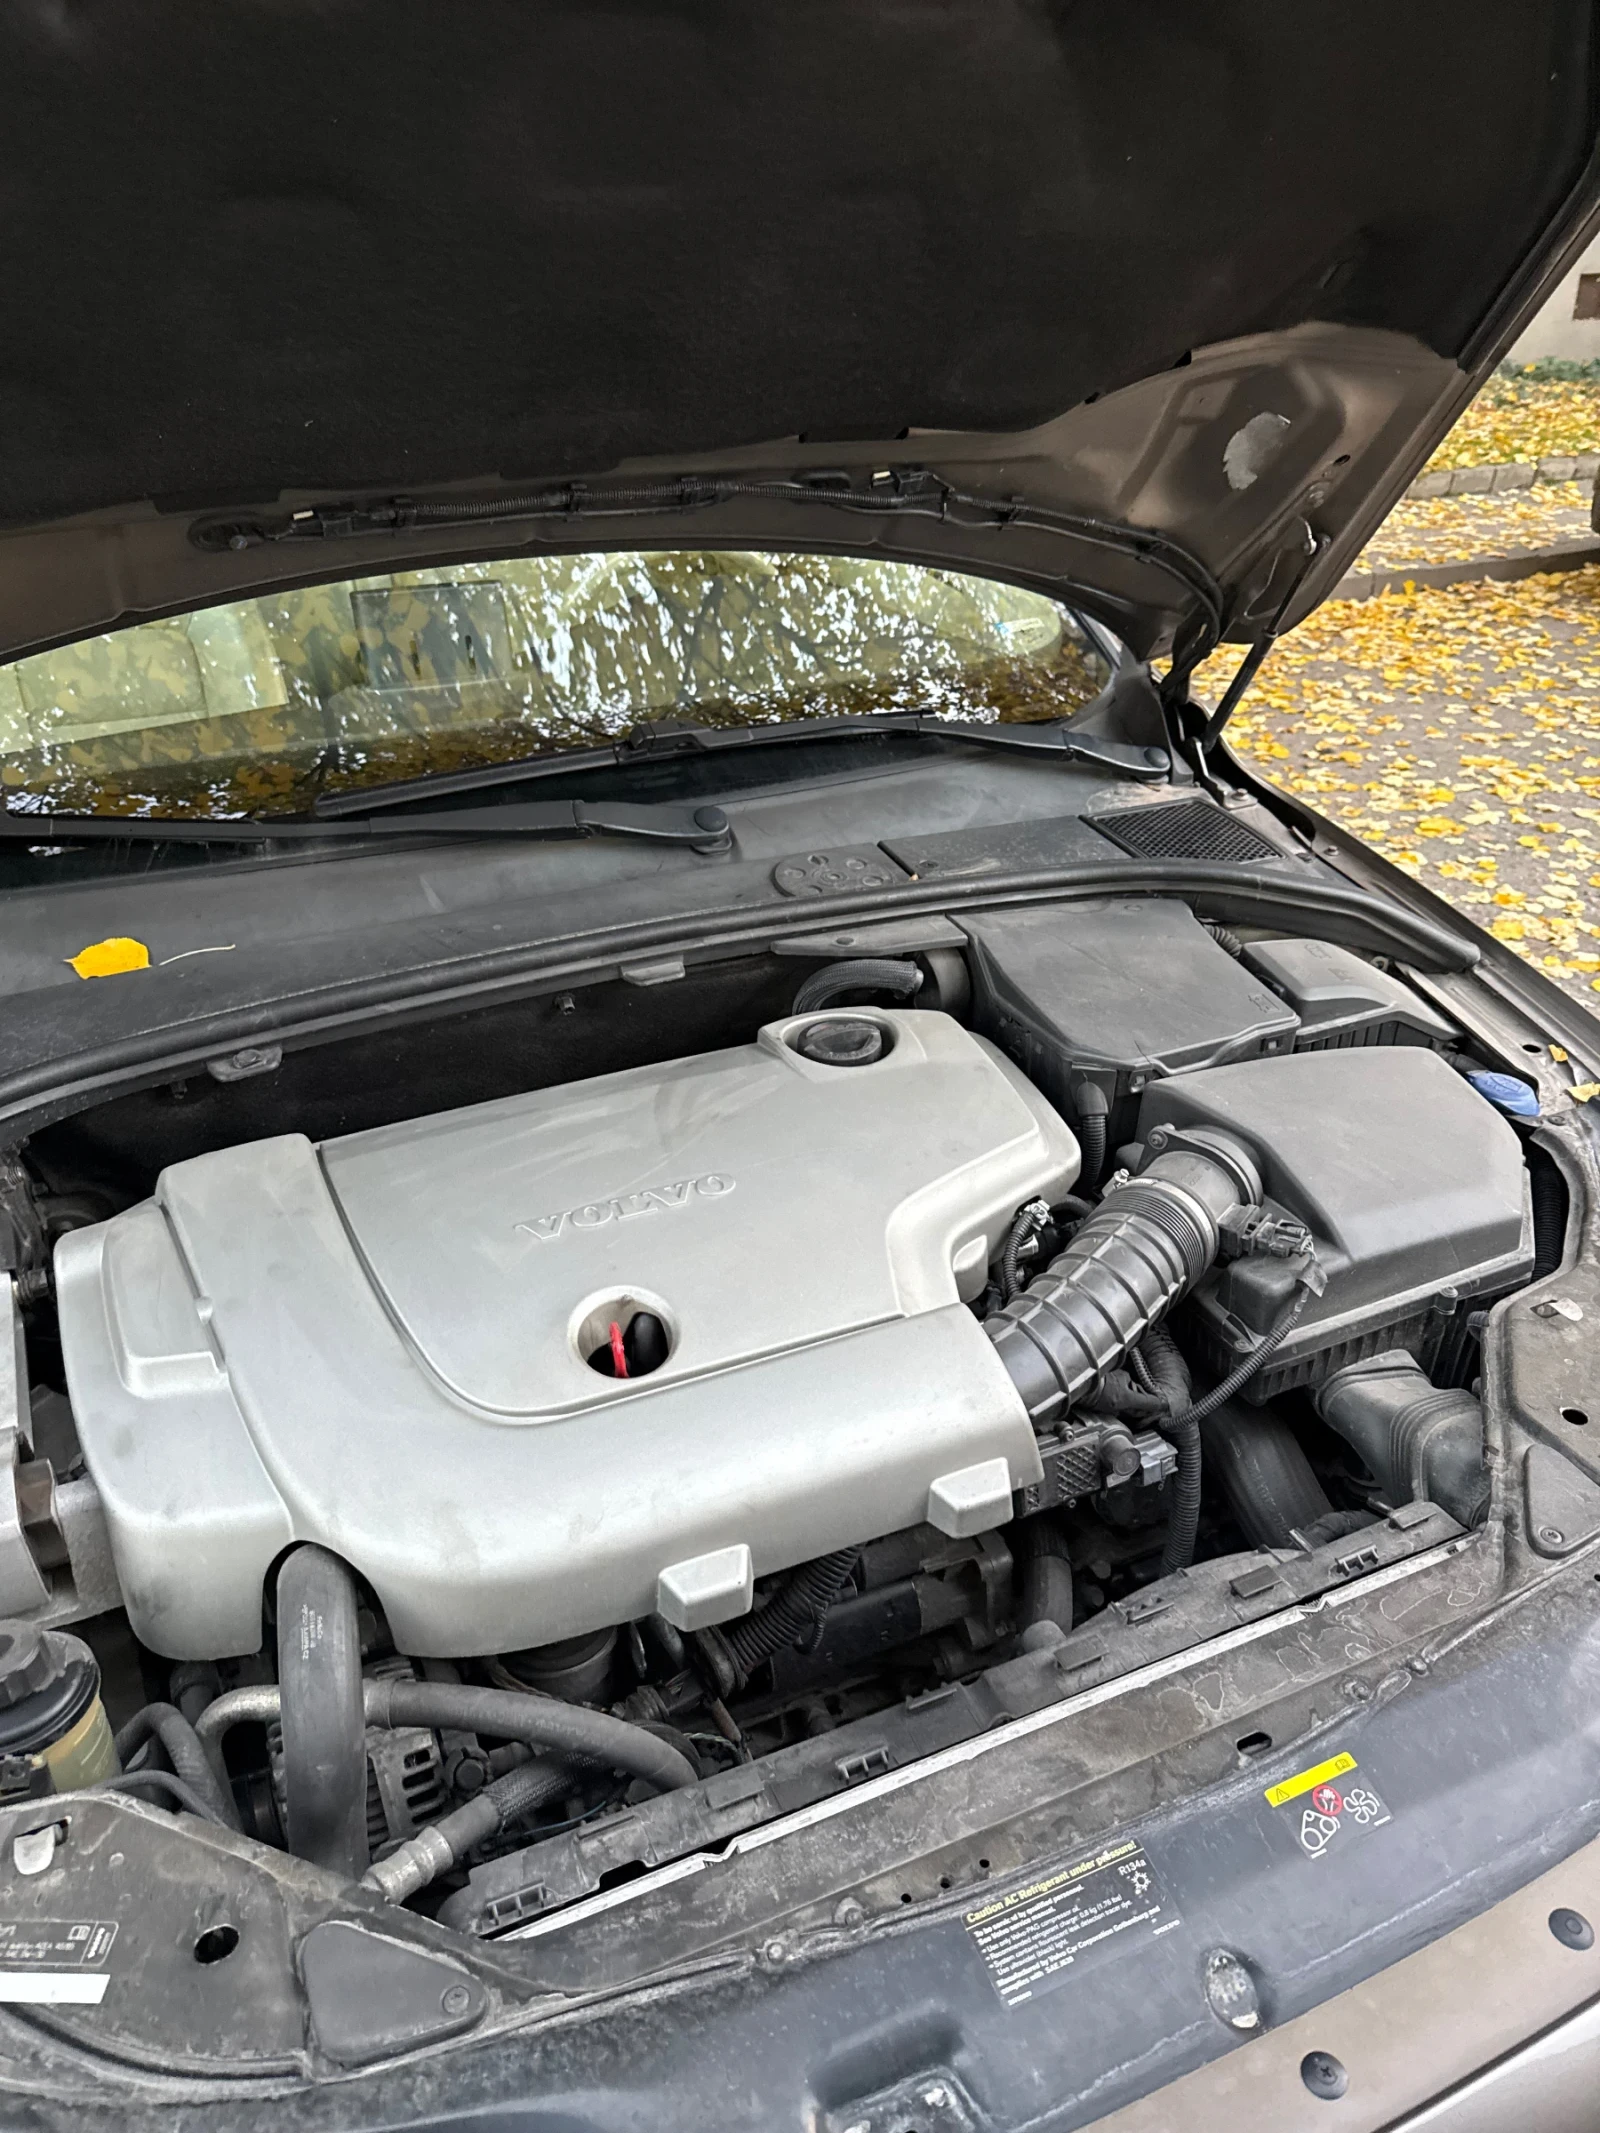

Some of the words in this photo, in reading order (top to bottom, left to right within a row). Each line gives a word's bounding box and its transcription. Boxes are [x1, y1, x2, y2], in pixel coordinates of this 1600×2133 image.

[513, 1172, 737, 1240] VOLVO
[1117, 1857, 1146, 1876] R134a
[965, 1900, 1004, 1923] Caution
[1002, 1892, 1020, 1907] AC
[1016, 1870, 1070, 1901] Refrigerant
[1068, 1858, 1096, 1877] under
[1079, 1911, 1105, 1927] detection
[973, 1929, 984, 1938] To
[982, 1924, 993, 1934] be
[1076, 1927, 1115, 1949] Corporation
[985, 1942, 999, 1952] Use
[998, 1936, 1012, 1948] only
[989, 1936, 1032, 1960] Recommended
[995, 1964, 1010, 1976] Use
